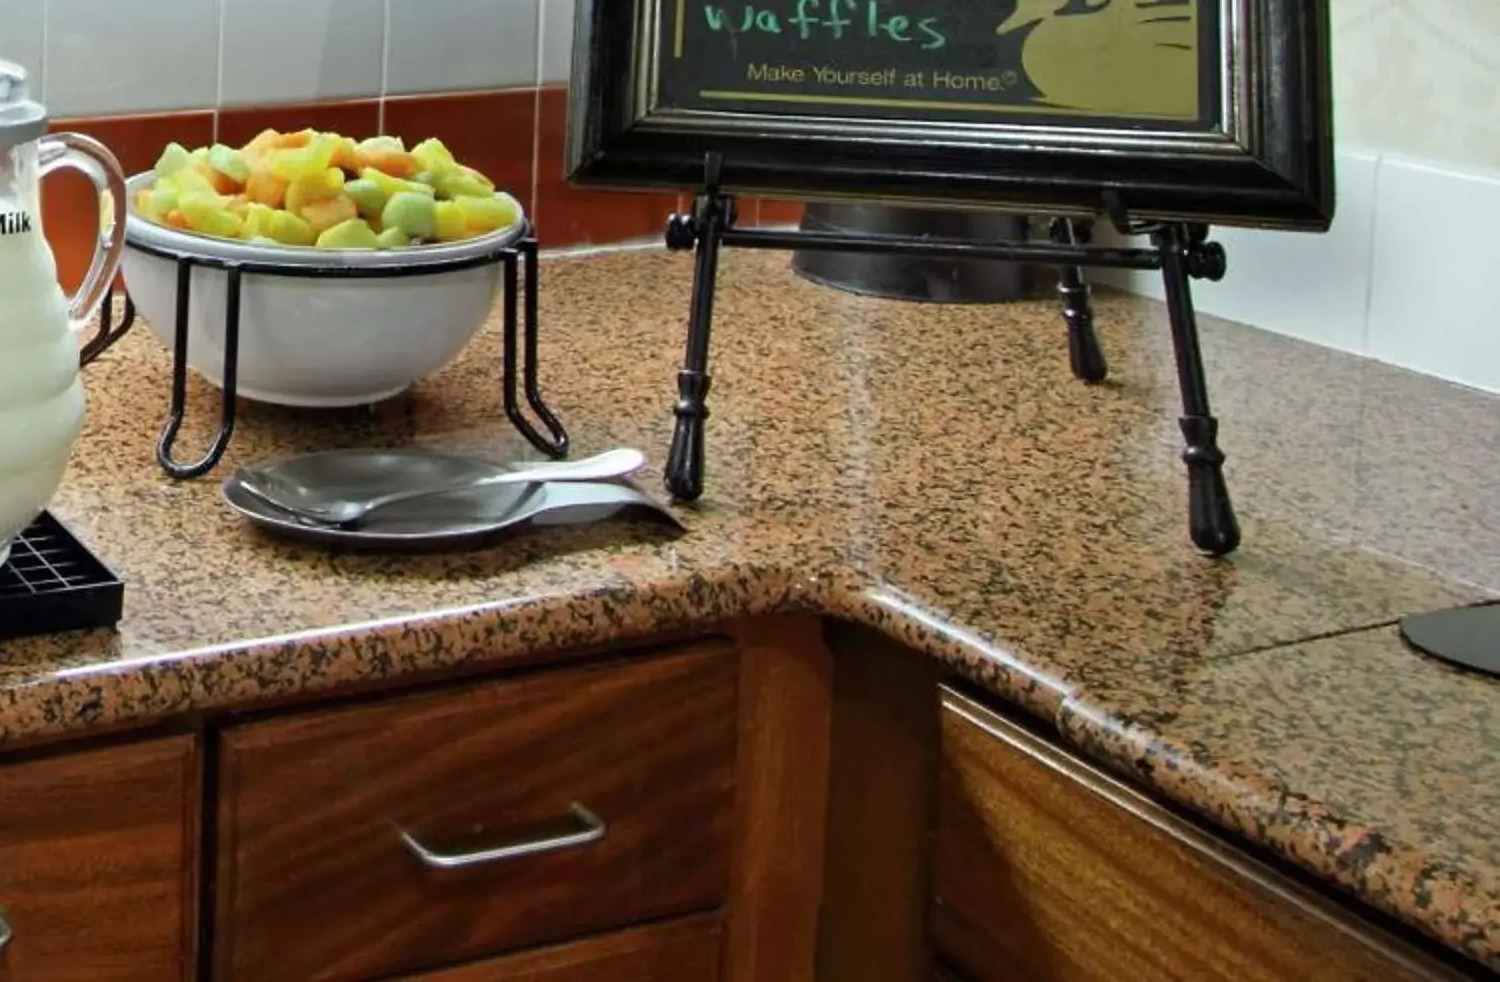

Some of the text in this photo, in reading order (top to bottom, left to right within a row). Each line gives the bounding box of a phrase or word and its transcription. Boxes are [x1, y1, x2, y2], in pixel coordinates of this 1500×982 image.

[747, 62, 805, 83] Make
[813, 66, 896, 87] Yourself
[903, 70, 925, 88] at
